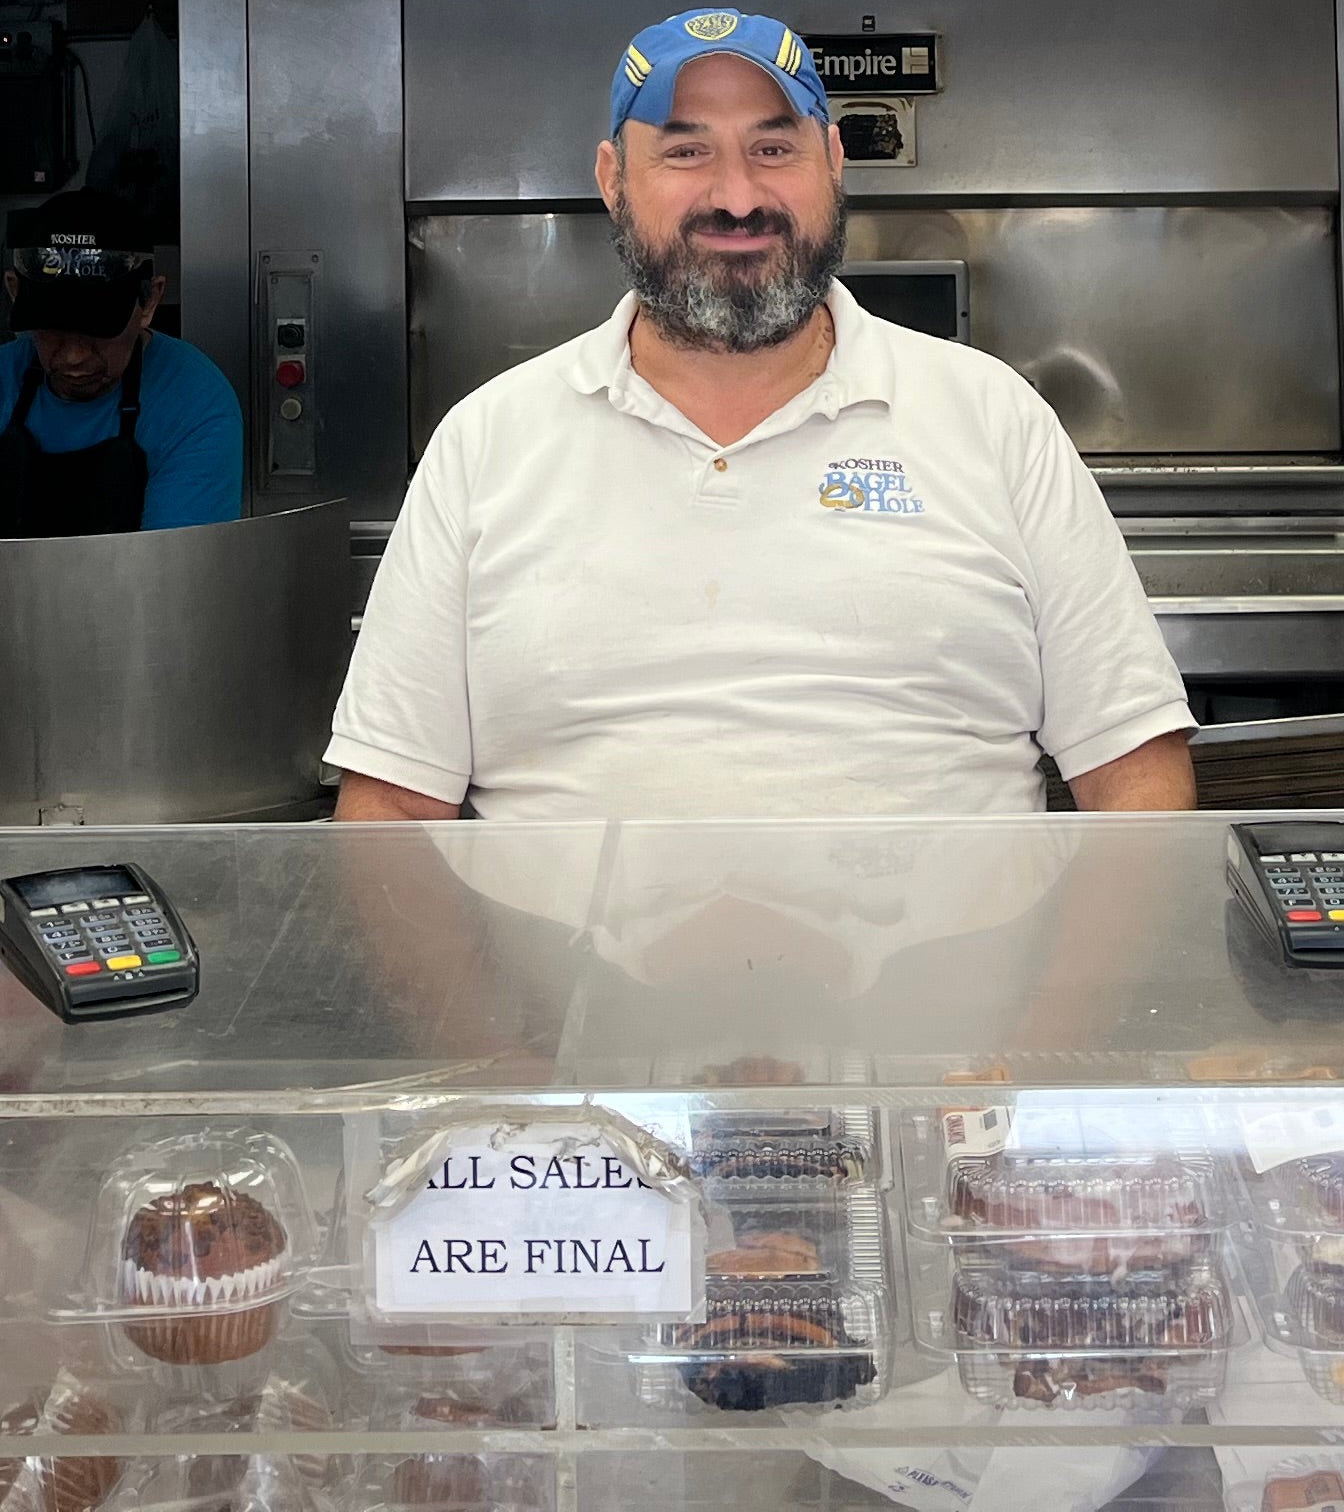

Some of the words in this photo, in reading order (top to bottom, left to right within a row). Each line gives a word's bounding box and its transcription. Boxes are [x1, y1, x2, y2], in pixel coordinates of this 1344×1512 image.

[814, 48, 897, 81] Empire
[51, 233, 96, 246] KOSHER
[827, 458, 905, 474] KOSHER
[818, 471, 912, 498] BAGEL
[863, 489, 926, 514] HOLE
[409, 1238, 509, 1275] ARE
[523, 1237, 666, 1275] FINAL
